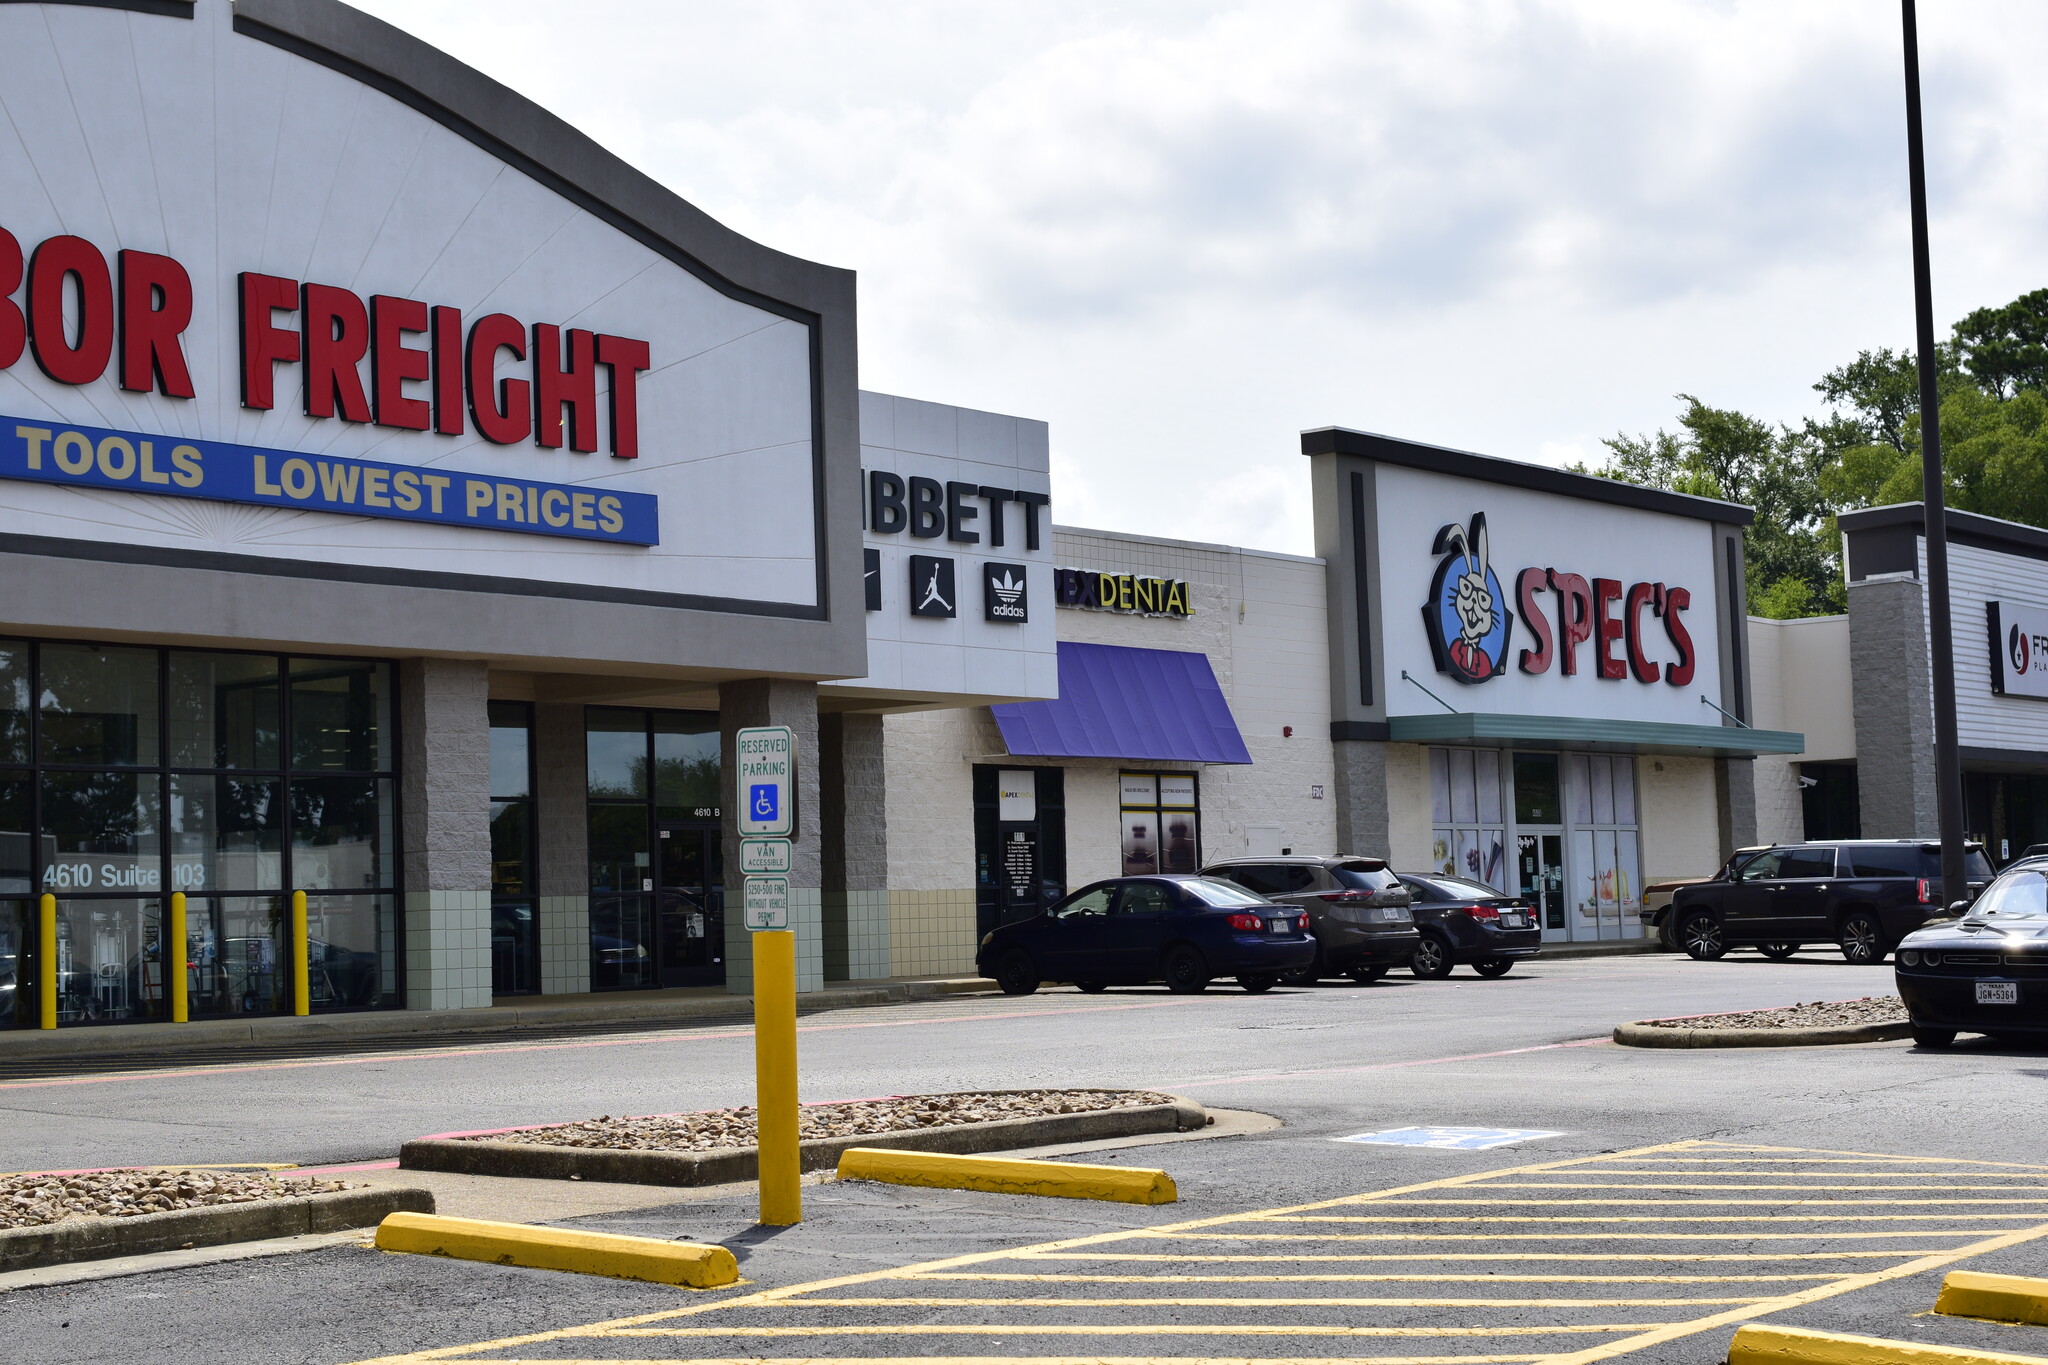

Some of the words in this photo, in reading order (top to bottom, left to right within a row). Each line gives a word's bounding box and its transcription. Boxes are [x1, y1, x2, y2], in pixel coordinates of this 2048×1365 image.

[237, 271, 650, 459] FREIGHT
[16, 426, 204, 488] TOOLS
[253, 455, 450, 513] LOWEST
[465, 480, 624, 533] PRICES
[992, 604, 1025, 618] adidas
[1515, 567, 1696, 686] SPEC'S
[741, 738, 788, 754] RESERVED
[742, 762, 785, 776] PARKING
[1312, 787, 1323, 797] FDC
[694, 808, 711, 817] 4610
[714, 808, 721, 817] B
[756, 847, 775, 857] VAN
[748, 858, 784, 866] ACCESSIBLE
[42, 863, 93, 888] 4610
[101, 864, 161, 887] Suite
[173, 863, 206, 886] 103
[748, 884, 773, 895] $250-500
[774, 884, 785, 895] FINE
[748, 898, 767, 909] WITHOUT
[769, 898, 786, 909] VEHICLE
[757, 911, 776, 922] PERMIT
